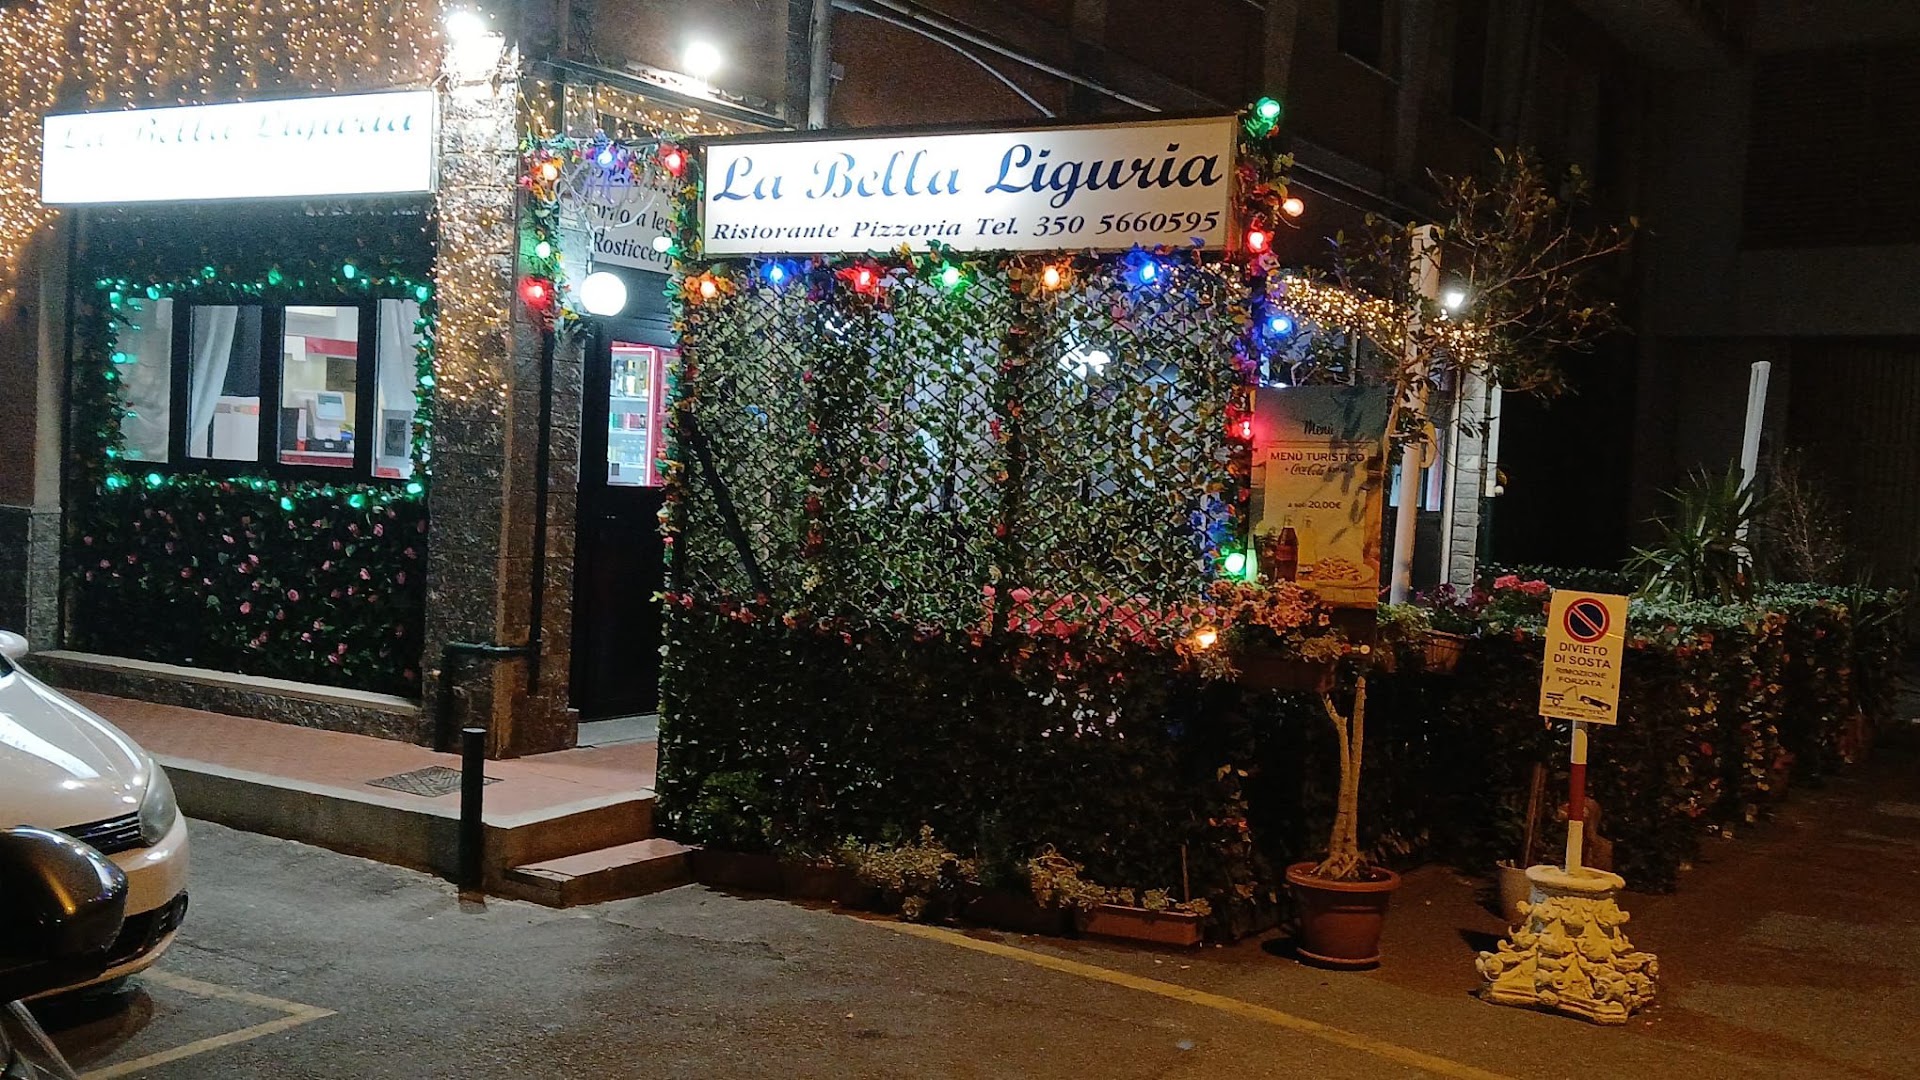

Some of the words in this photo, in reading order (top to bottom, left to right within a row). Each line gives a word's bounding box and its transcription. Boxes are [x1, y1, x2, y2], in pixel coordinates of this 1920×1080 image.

[712, 155, 783, 203] La
[805, 148, 961, 199] Bella
[985, 143, 1223, 208] Liguria
[711, 221, 841, 241] Ristorante
[852, 219, 963, 239] Pizzeria
[976, 217, 1019, 237] Tel.
[1032, 215, 1086, 237] 350
[1099, 211, 1221, 234] 5660595
[1307, 452, 1365, 462] TURISTICO
[1559, 642, 1608, 656] DIVIETO
[1554, 654, 1566, 664] DI
[1569, 655, 1611, 669] SOSTA
[1555, 667, 1607, 679] RIMOZIONE
[1558, 677, 1602, 687] FORZATA
